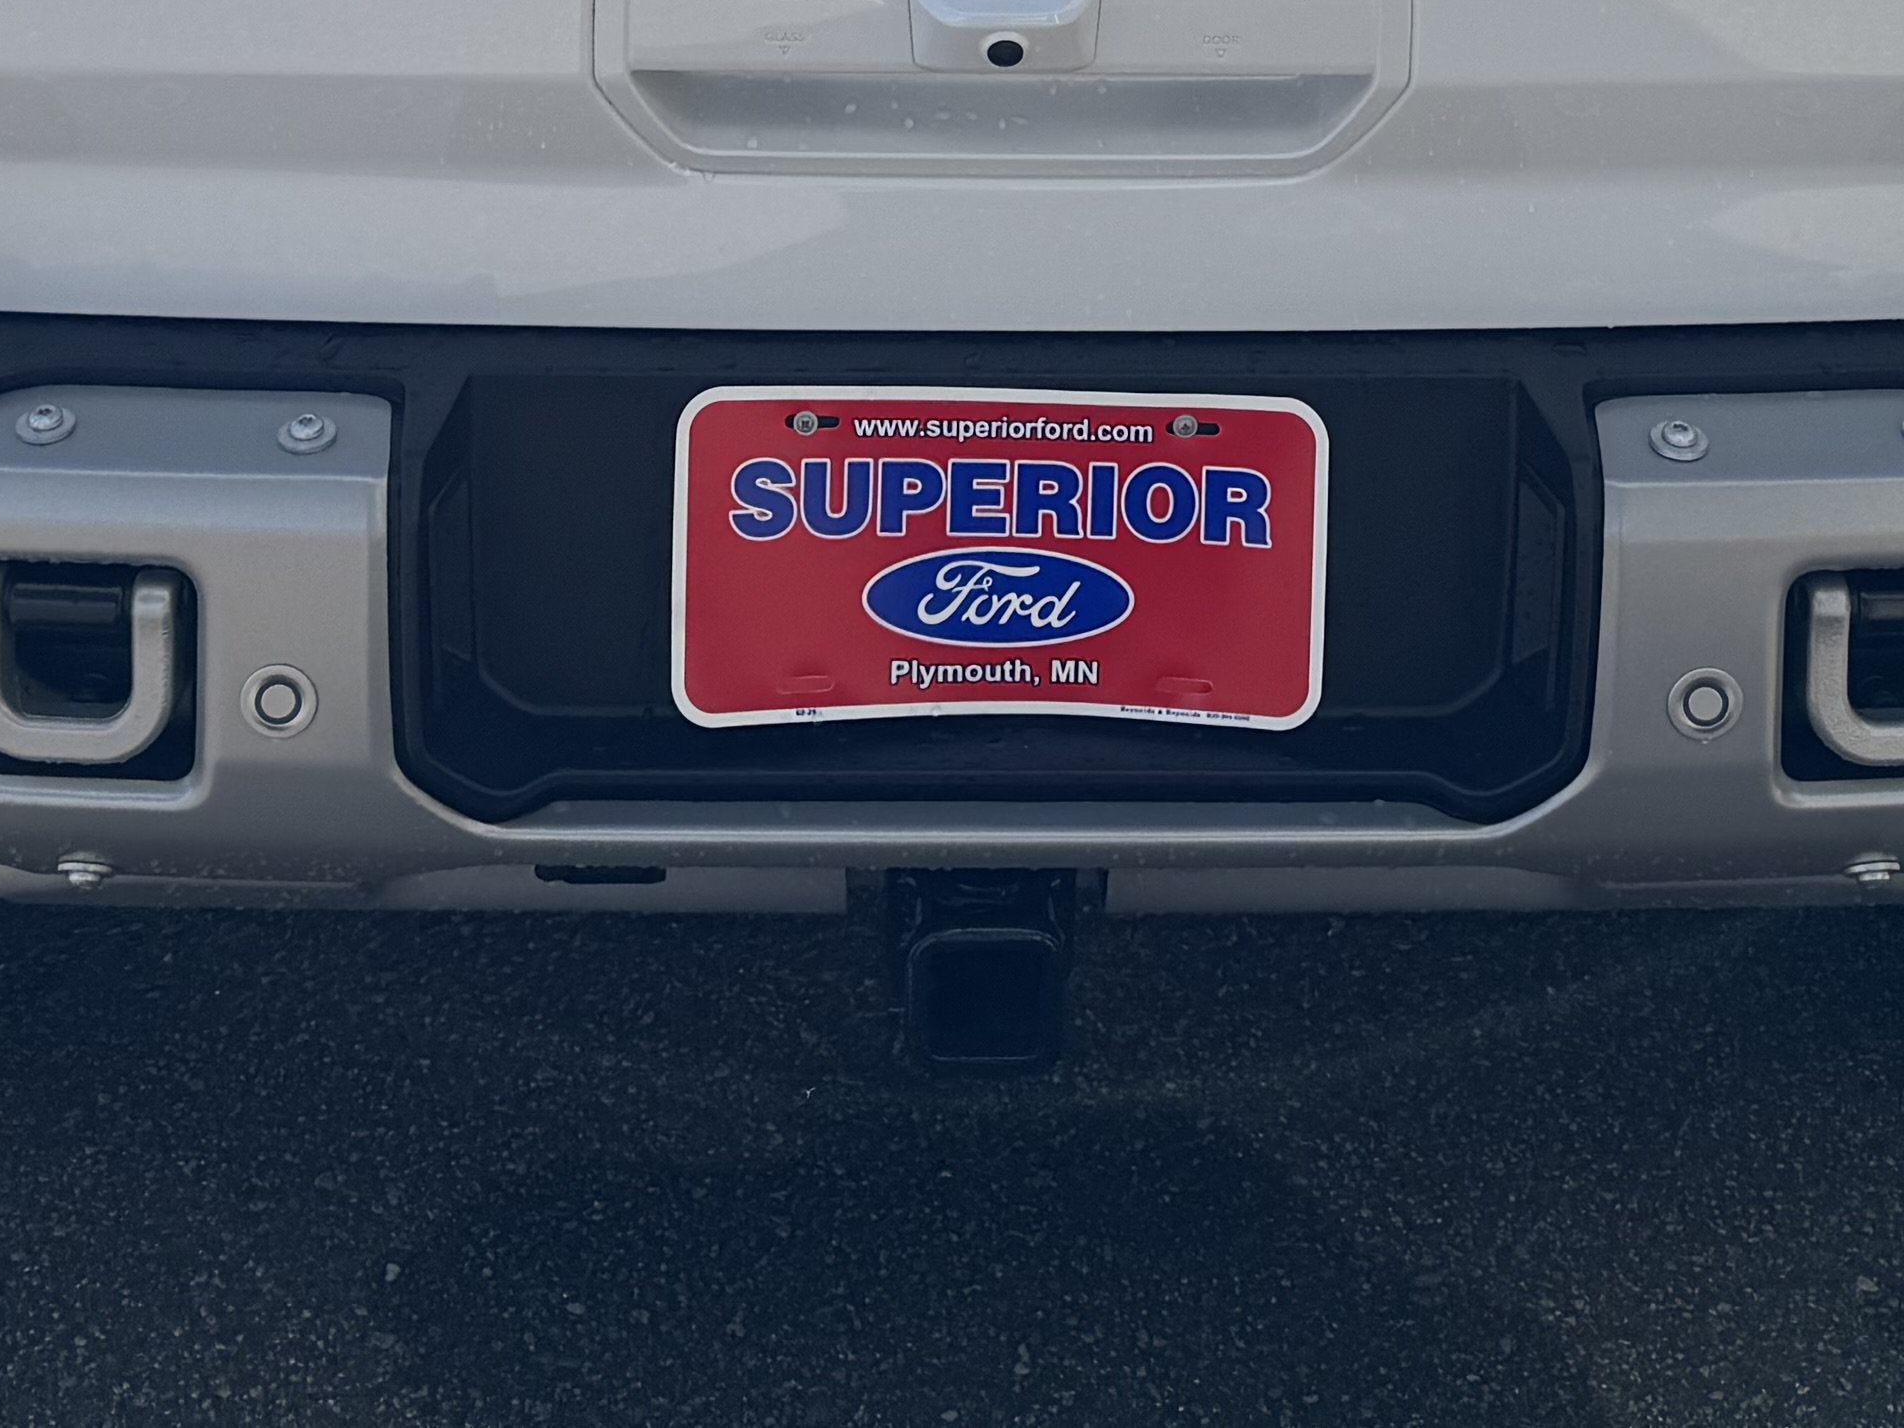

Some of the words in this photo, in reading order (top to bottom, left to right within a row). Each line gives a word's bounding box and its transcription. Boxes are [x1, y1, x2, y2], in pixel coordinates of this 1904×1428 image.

[853, 416, 1154, 444] www.superiorford.com
[727, 456, 1273, 549] SUPERIOR
[915, 559, 1079, 629] Ford
[889, 658, 1042, 689] Plymouth,
[1050, 660, 1100, 686] MN
